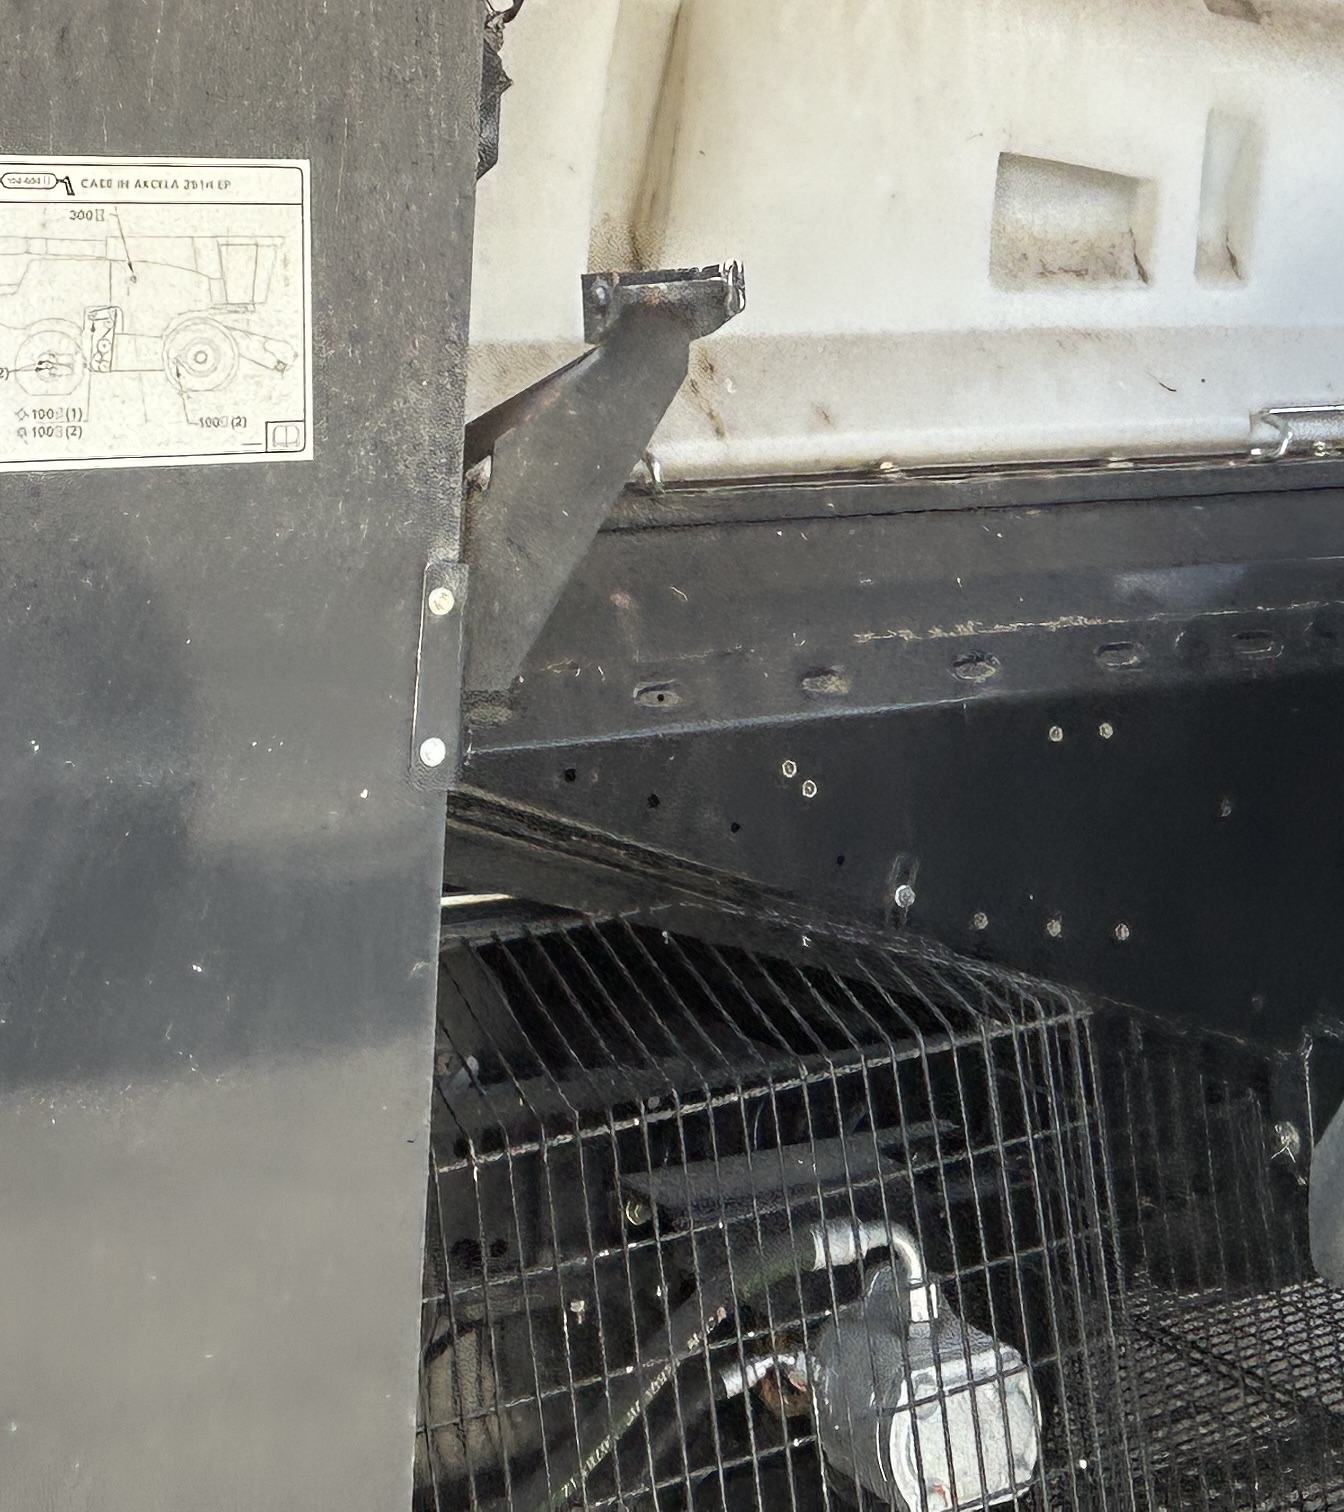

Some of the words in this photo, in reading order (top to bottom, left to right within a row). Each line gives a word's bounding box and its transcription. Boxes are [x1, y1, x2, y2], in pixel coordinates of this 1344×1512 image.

[32, 408, 54, 420] 100
[66, 408, 83, 422] (1)
[32, 425, 54, 438] 100
[66, 425, 83, 439] (2)
